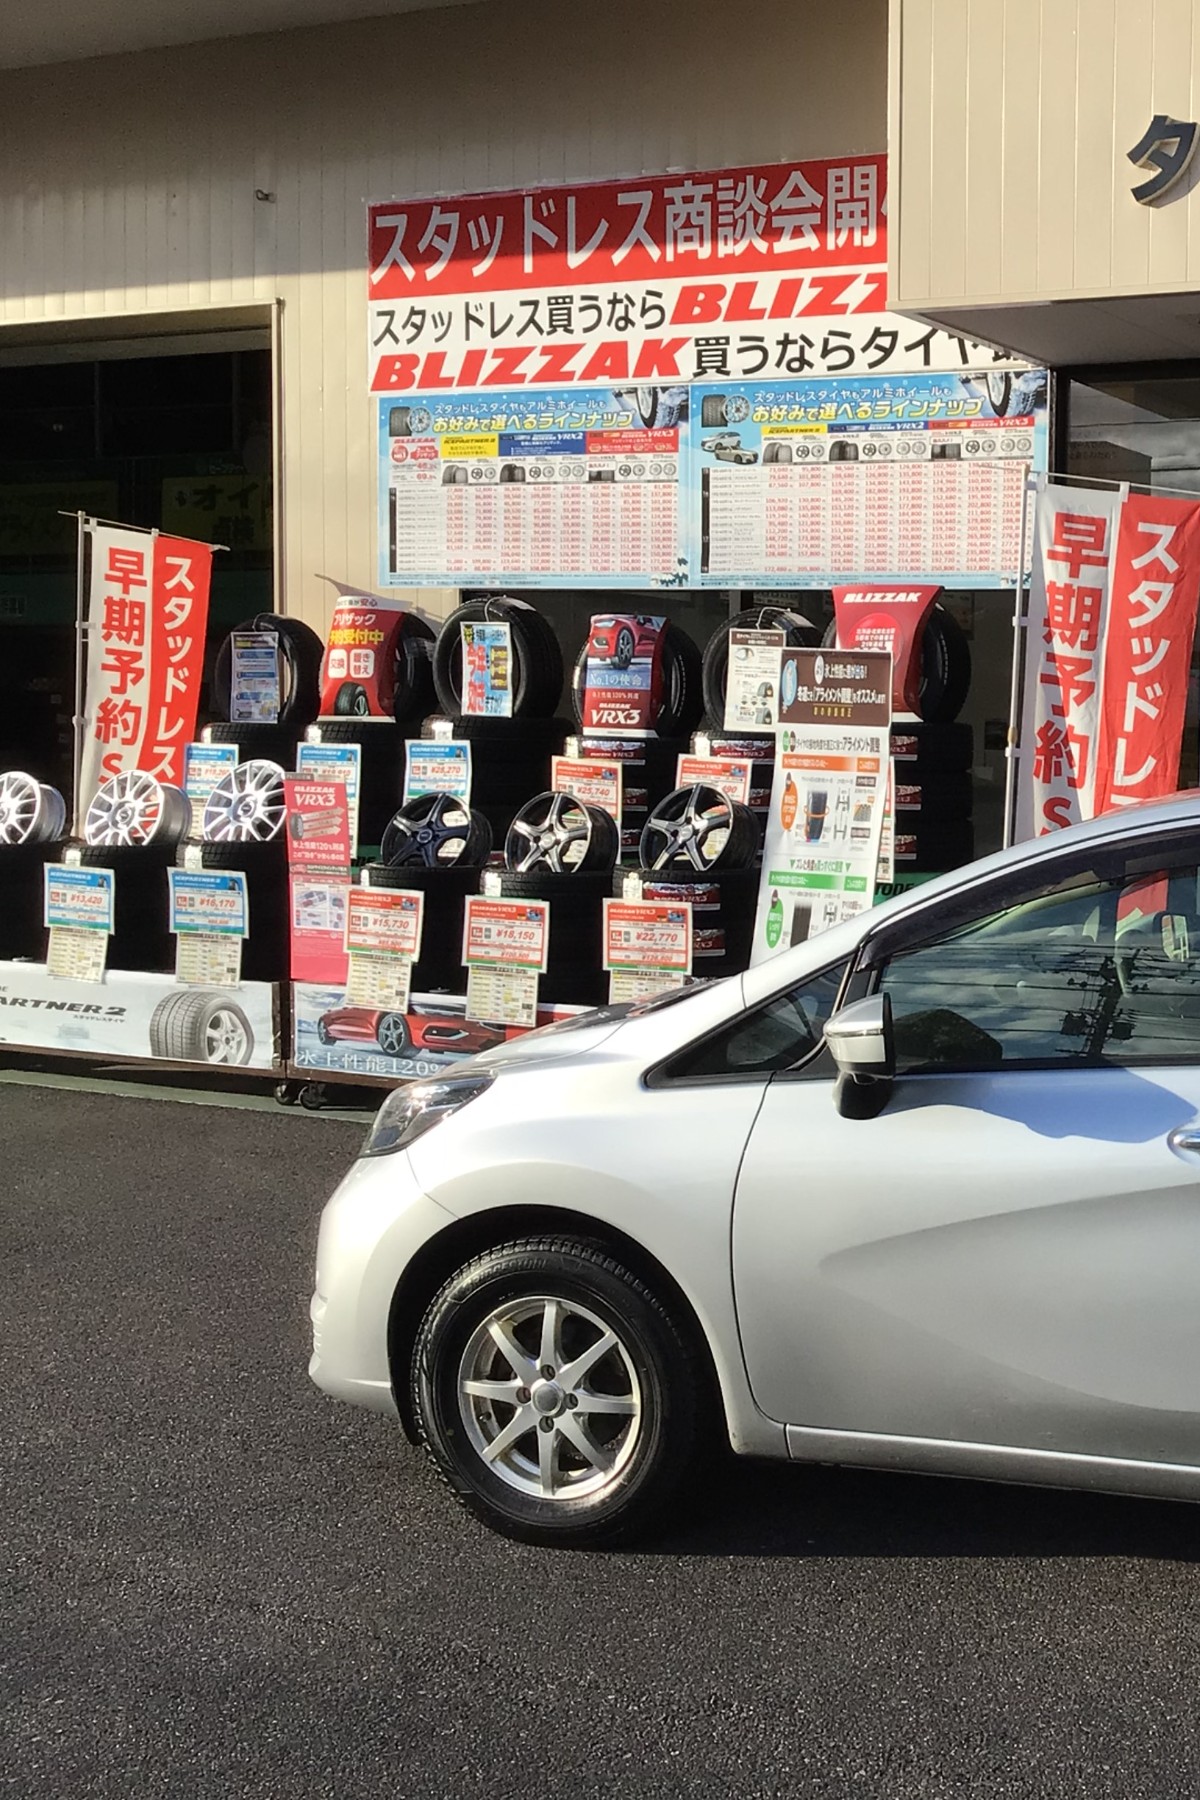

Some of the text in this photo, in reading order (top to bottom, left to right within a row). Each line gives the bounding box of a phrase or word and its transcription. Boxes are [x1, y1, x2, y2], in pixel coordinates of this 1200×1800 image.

[370, 164, 887, 288] スタッドレス商談会開
[753, 386, 952, 403] スタッドレスタイヤもアルミホイールも
[433, 399, 607, 415] スタッドレスタイヤもアルミホイールも
[751, 395, 985, 422] お好みで選べるラインナップ
[432, 407, 635, 433] お好みで選べるラインナップ
[842, 592, 922, 603] BLIZZAK
[149, 555, 196, 779] スタッドレス
[1111, 521, 1179, 807] スタッドレ
[590, 709, 642, 725] VRX3
[294, 785, 336, 794] BLIZZAK
[577, 785, 610, 796] ¥25,740
[295, 793, 336, 807] VRX3
[70, 893, 103, 905] ¥13,420
[199, 897, 236, 909] ¥16,170
[372, 917, 410, 930] ¥15,730
[496, 929, 535, 941] ¥18,150
[636, 931, 678, 942] ¥22,770
